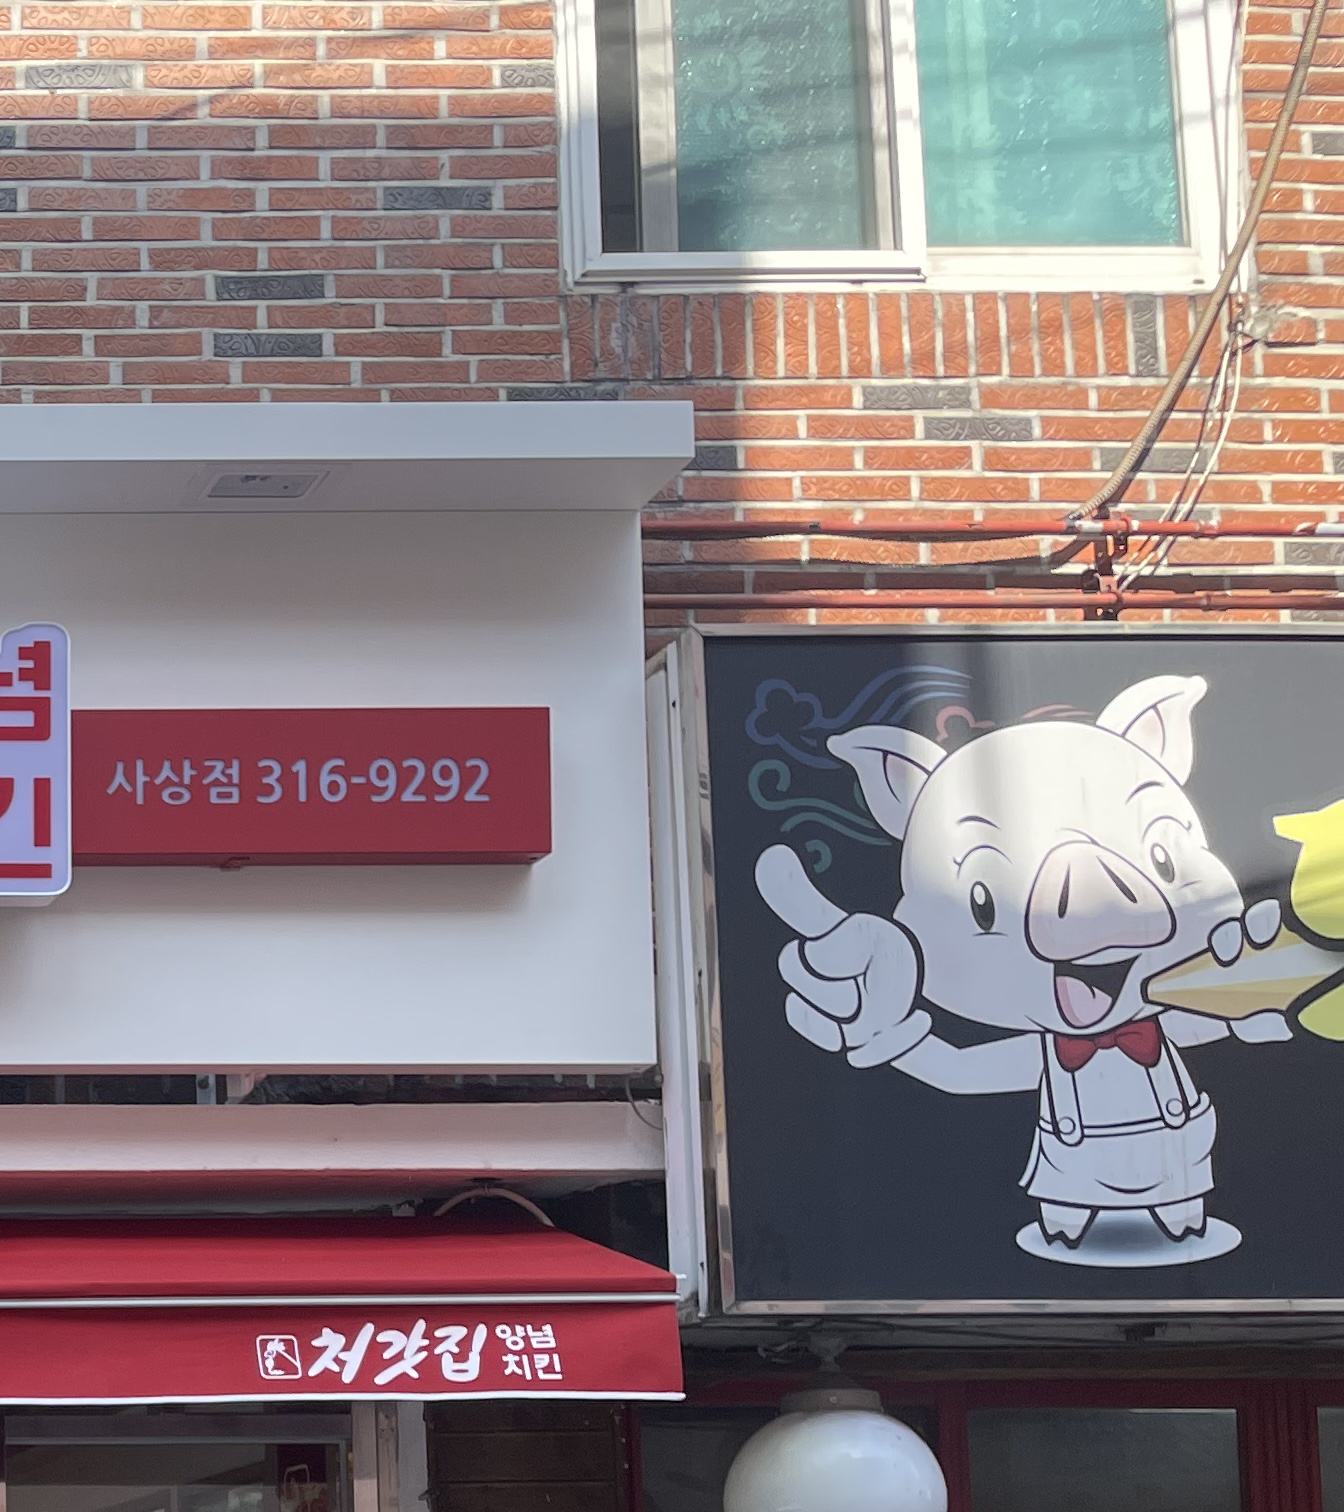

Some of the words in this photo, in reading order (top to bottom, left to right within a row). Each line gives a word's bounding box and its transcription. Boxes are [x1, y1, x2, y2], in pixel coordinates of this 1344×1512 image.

[107, 758, 241, 806] 사상점
[257, 758, 491, 805] 316-9292
[308, 1318, 487, 1385] 처갓집
[496, 1323, 557, 1350] 양념
[502, 1352, 563, 1380] 치킨
